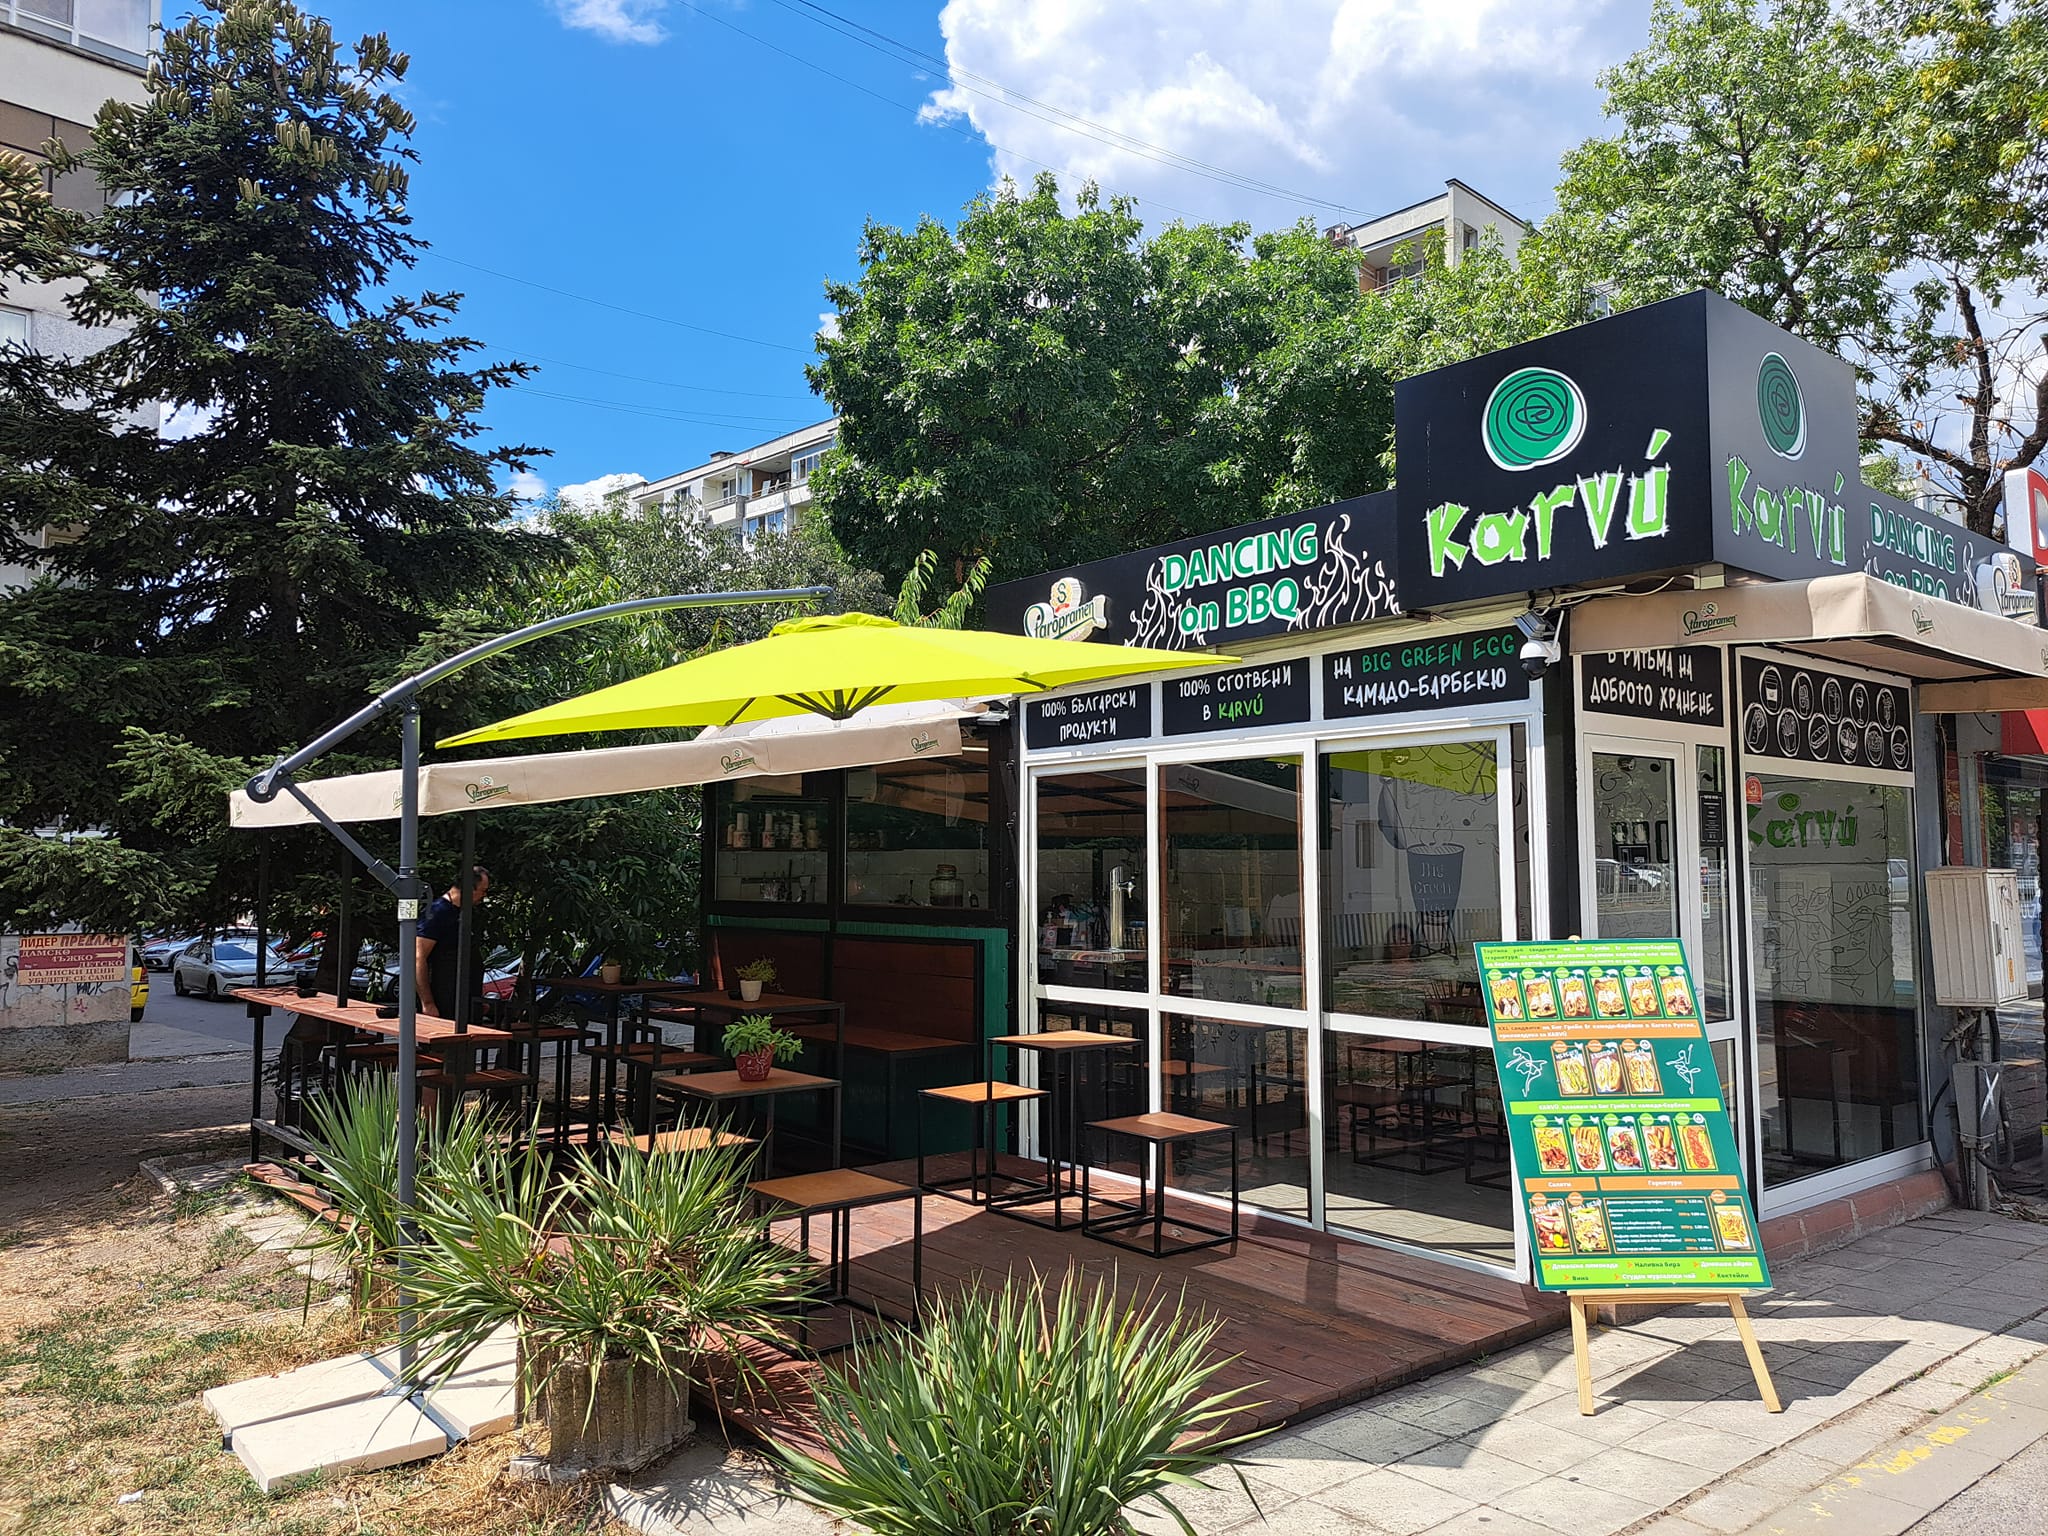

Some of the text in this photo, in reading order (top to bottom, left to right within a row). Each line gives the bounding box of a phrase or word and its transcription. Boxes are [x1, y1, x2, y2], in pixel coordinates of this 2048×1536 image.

[1424, 428, 1672, 578] Karvú
[1727, 454, 1849, 567] Karvú
[1164, 522, 1319, 592] DANCING
[1870, 502, 1956, 574] DANCING
[1179, 577, 1302, 636] on BBQ
[1333, 634, 1515, 679] НА BIG GREEN EGG
[1679, 653, 1693, 682] НА
[1179, 665, 1291, 698] 100% СГОТВЕНИ
[1343, 667, 1507, 708] КАМАДО-БАРБЕКЮ
[1590, 676, 1714, 717] ДОБРОТО ХРАНЕНЕ
[1041, 690, 1136, 718] 100% БЪЛГАРСКИ
[1203, 693, 1263, 722] В KARVÚ
[1060, 717, 1116, 742] ПРОДУКТИ
[20, 937, 57, 948] ЛИДЕР
[21, 949, 70, 958] ДАМСКО
